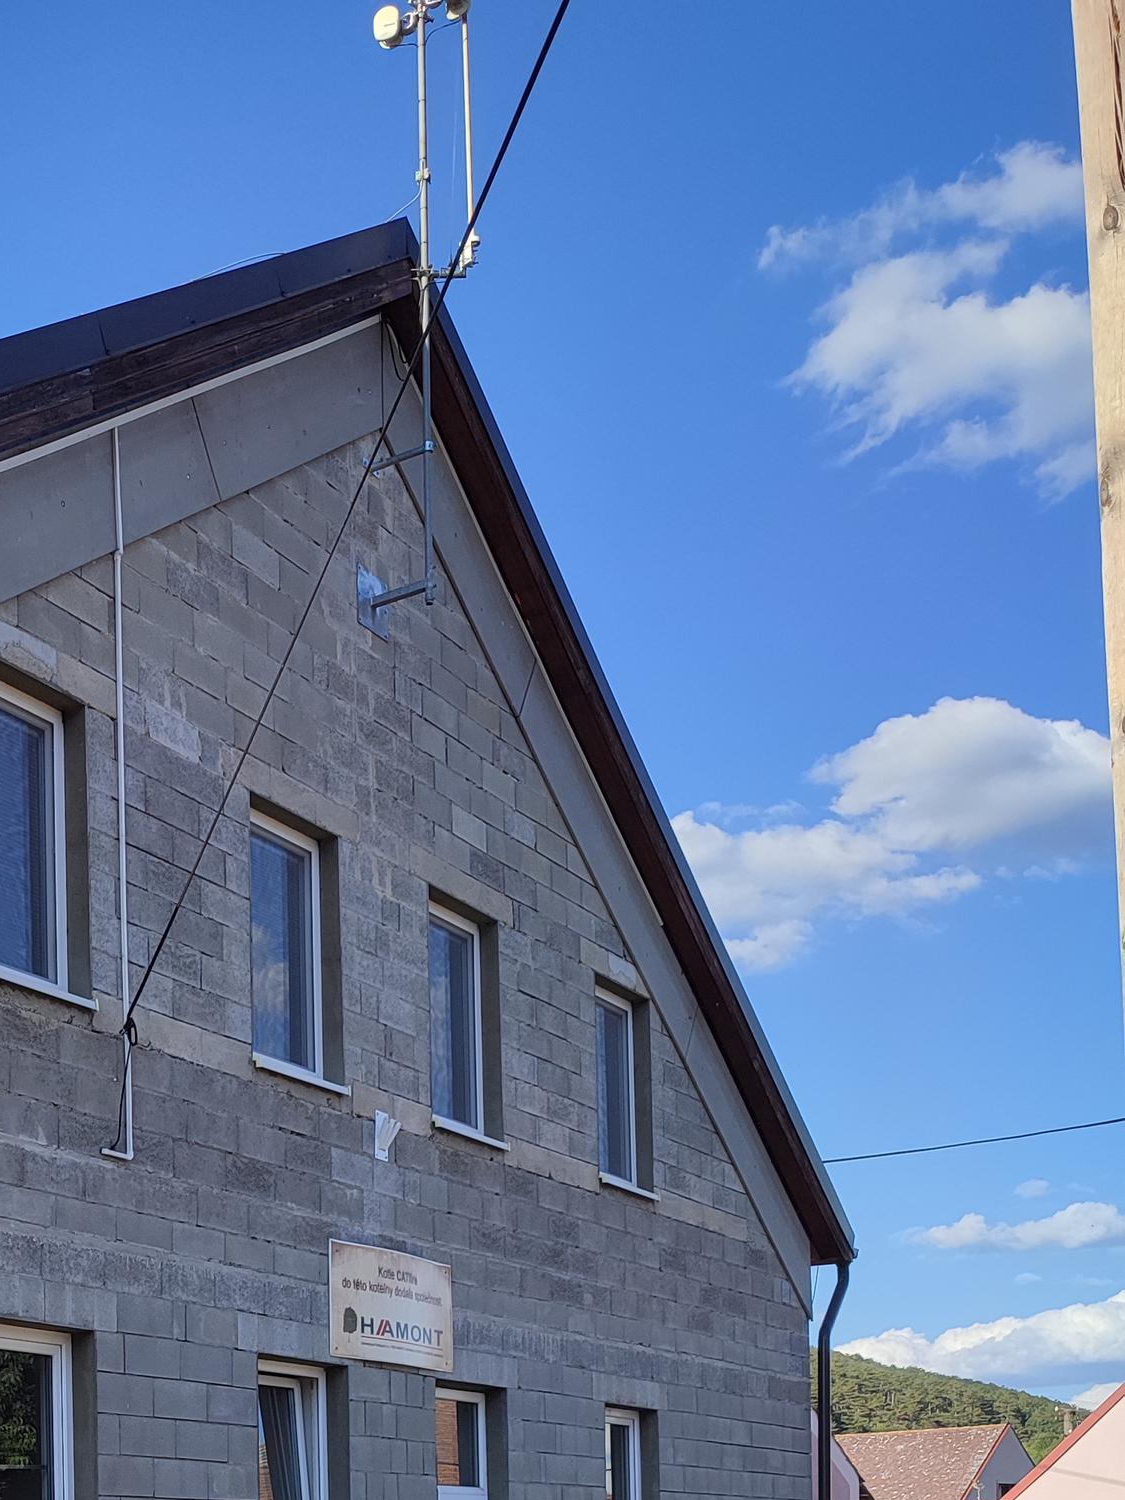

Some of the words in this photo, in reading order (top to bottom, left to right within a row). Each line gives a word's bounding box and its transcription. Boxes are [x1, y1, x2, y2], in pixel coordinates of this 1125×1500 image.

[378, 1266, 395, 1280] Kotle
[342, 1277, 352, 1289] do
[353, 1278, 367, 1292] této
[368, 1281, 394, 1298] kotelny
